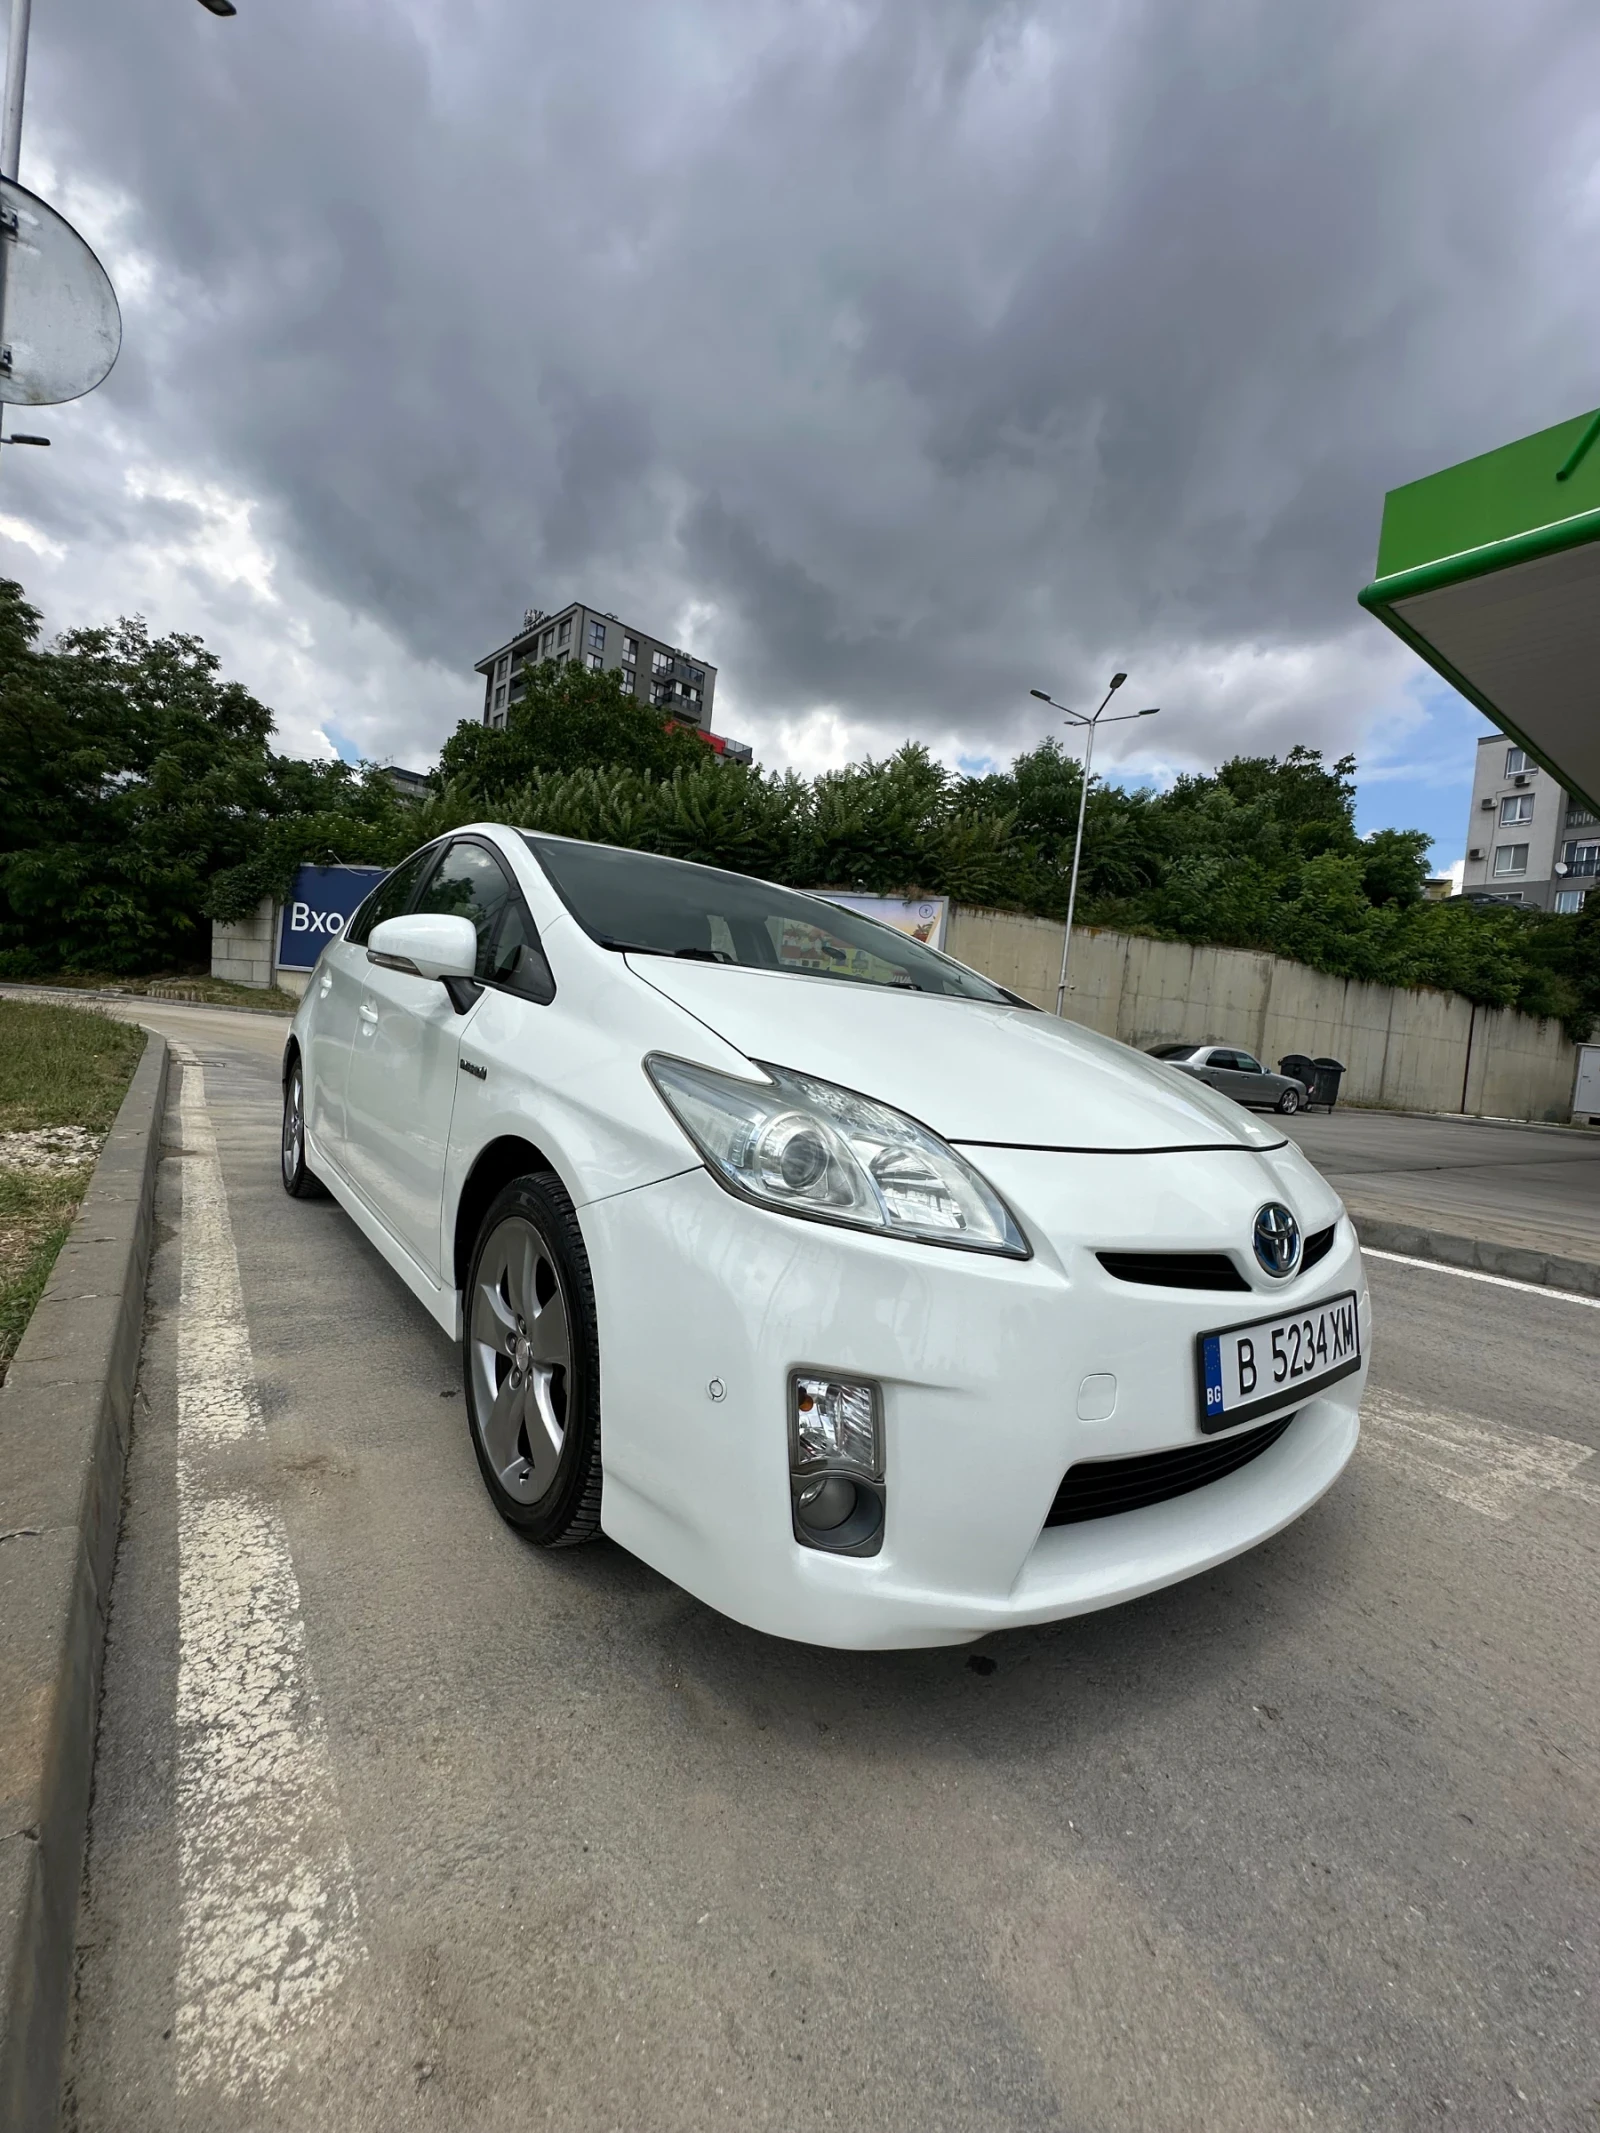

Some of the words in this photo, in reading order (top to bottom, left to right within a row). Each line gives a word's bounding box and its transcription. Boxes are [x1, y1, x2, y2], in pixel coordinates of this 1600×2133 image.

[1237, 1338, 1257, 1395] B
[1271, 1314, 1328, 1383] 5234
[1329, 1304, 1354, 1360] XM
[1206, 1385, 1221, 1405] BG
